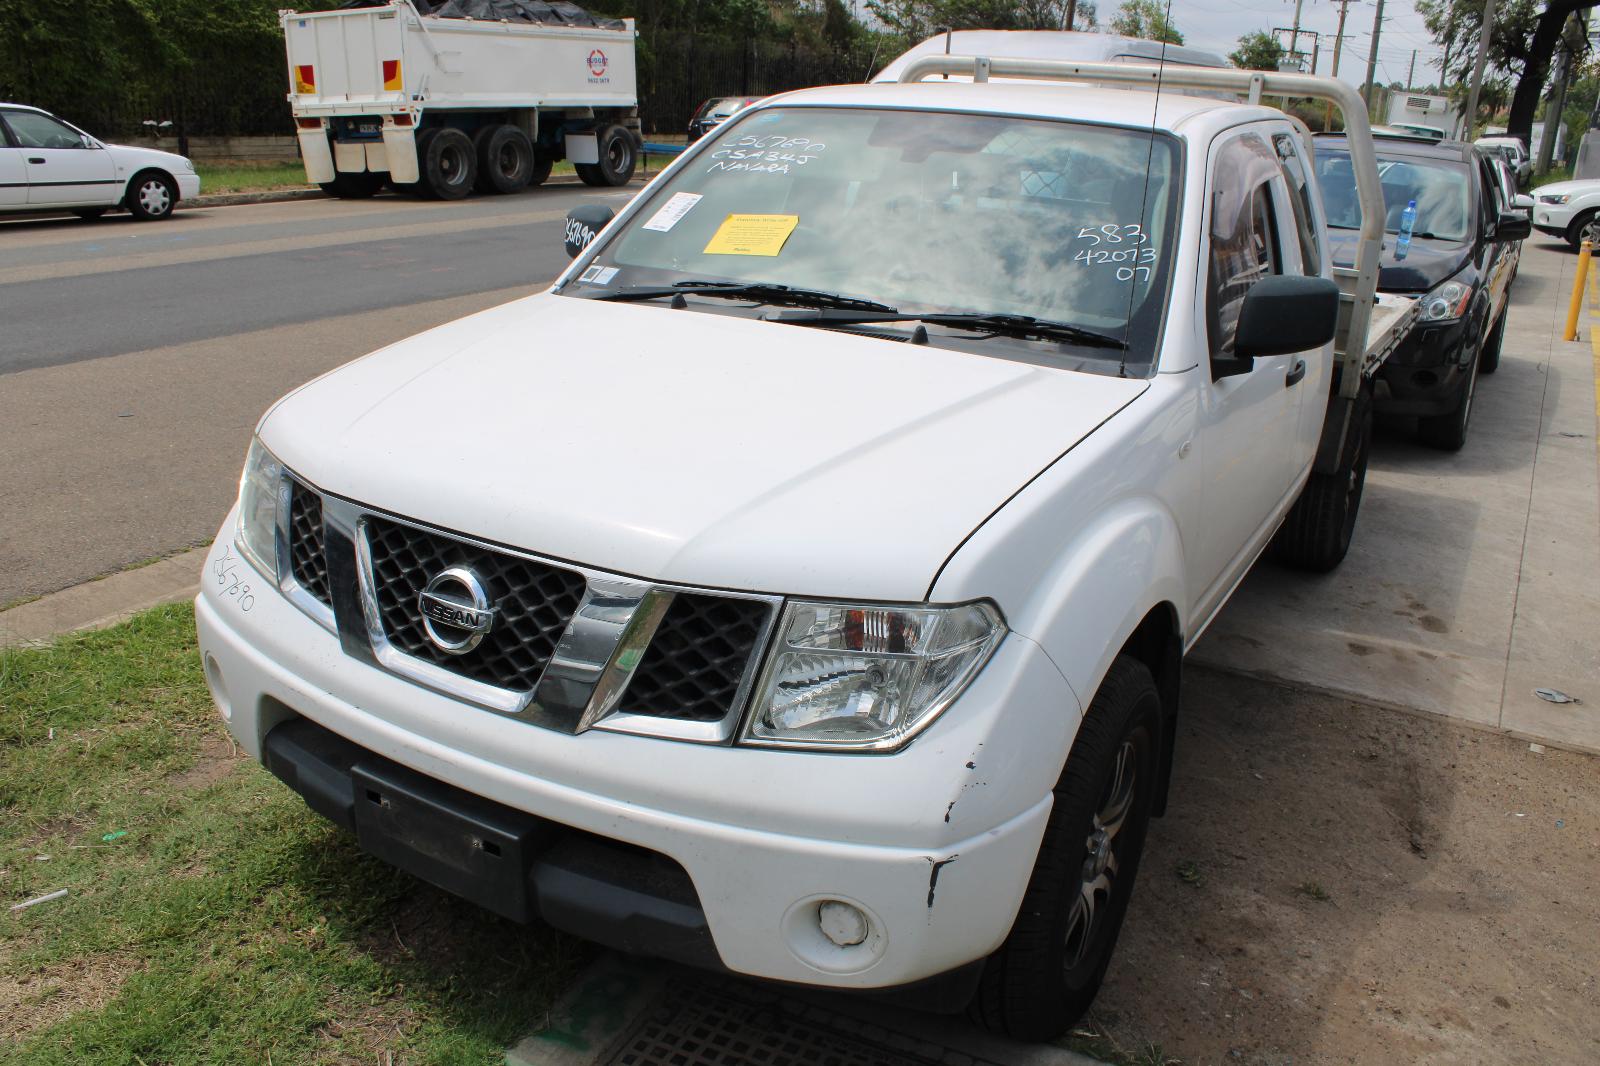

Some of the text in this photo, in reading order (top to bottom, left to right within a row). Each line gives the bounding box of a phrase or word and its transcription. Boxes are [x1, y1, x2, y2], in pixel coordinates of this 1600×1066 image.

[1077, 223, 1147, 246] 583
[1116, 267, 1150, 282] 07
[423, 598, 480, 627] NISSAN
